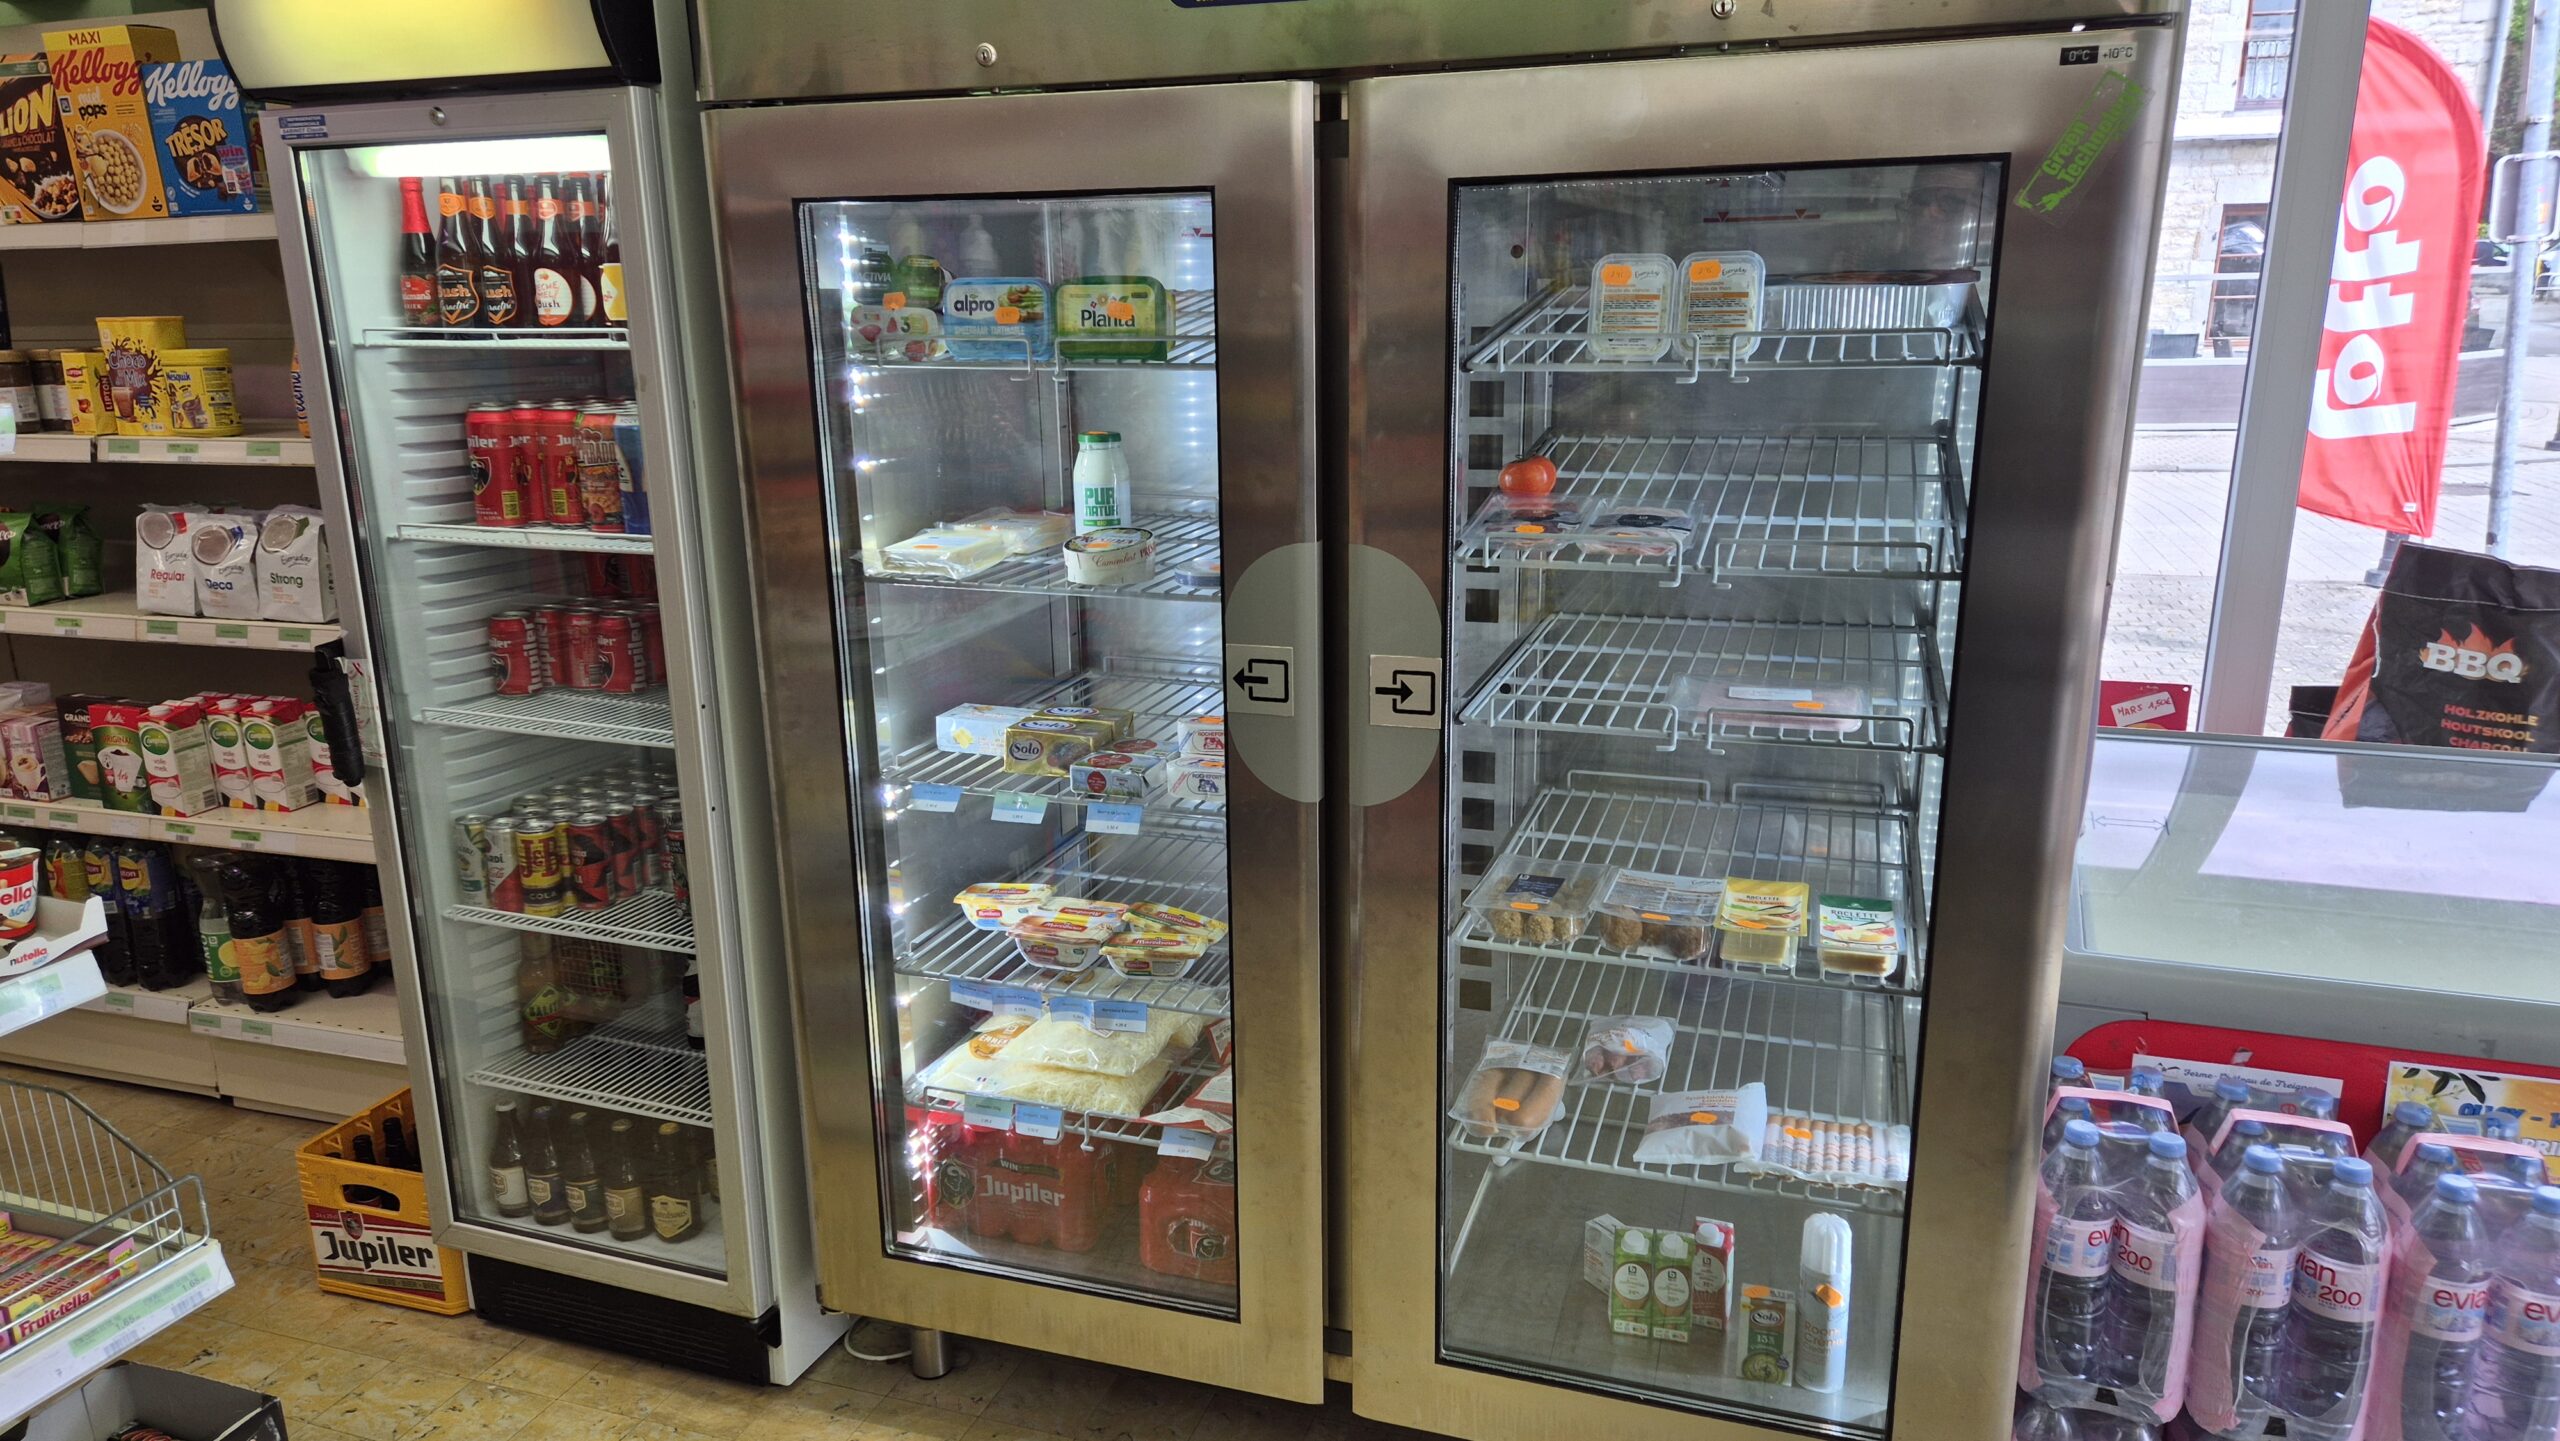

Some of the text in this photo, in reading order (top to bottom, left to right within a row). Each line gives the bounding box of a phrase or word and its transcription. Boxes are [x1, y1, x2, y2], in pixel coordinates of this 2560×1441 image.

[68, 31, 102, 46] MAXI
[2068, 47, 2134, 61] 0°C +10°C
[0, 83, 53, 136] LION
[78, 104, 108, 120] pops
[165, 118, 228, 157] TRÉSOR
[2042, 120, 2089, 176] Green
[486, 285, 512, 298] ush
[954, 295, 995, 316] alpro
[108, 350, 147, 369] Choco
[123, 369, 148, 388] Mix
[165, 371, 192, 382] Nesquik
[101, 376, 114, 411] LIPTON
[1085, 487, 1115, 505] PUR
[281, 553, 312, 567] Everyday
[1092, 552, 1136, 567] Camembert
[150, 568, 185, 583] Regular
[204, 578, 234, 591] Deca
[270, 572, 304, 588] Strong
[2423, 642, 2523, 684] BBQ
[2117, 704, 2143, 717] MARS
[2444, 704, 2539, 727] HOLZKOHLE
[2441, 718, 2536, 742] HOUTSKOOL
[1012, 742, 1040, 755] Solo
[529, 891, 558, 901] COLA
[1831, 909, 1880, 918] RACLETTE
[10, 947, 48, 966] nutella
[2184, 1068, 2213, 1079] Ferme
[2259, 1078, 2272, 1087] de
[1000, 1159, 1018, 1171] WIN
[979, 1174, 1065, 1206] Jupiler
[320, 1230, 433, 1270] Jupiler
[2118, 1245, 2152, 1271] 200
[2318, 1285, 2362, 1307] 200
[18, 1289, 94, 1339] Fruit-tella
[1755, 1311, 1779, 1321] Solo
[1804, 1321, 1841, 1337] Room
